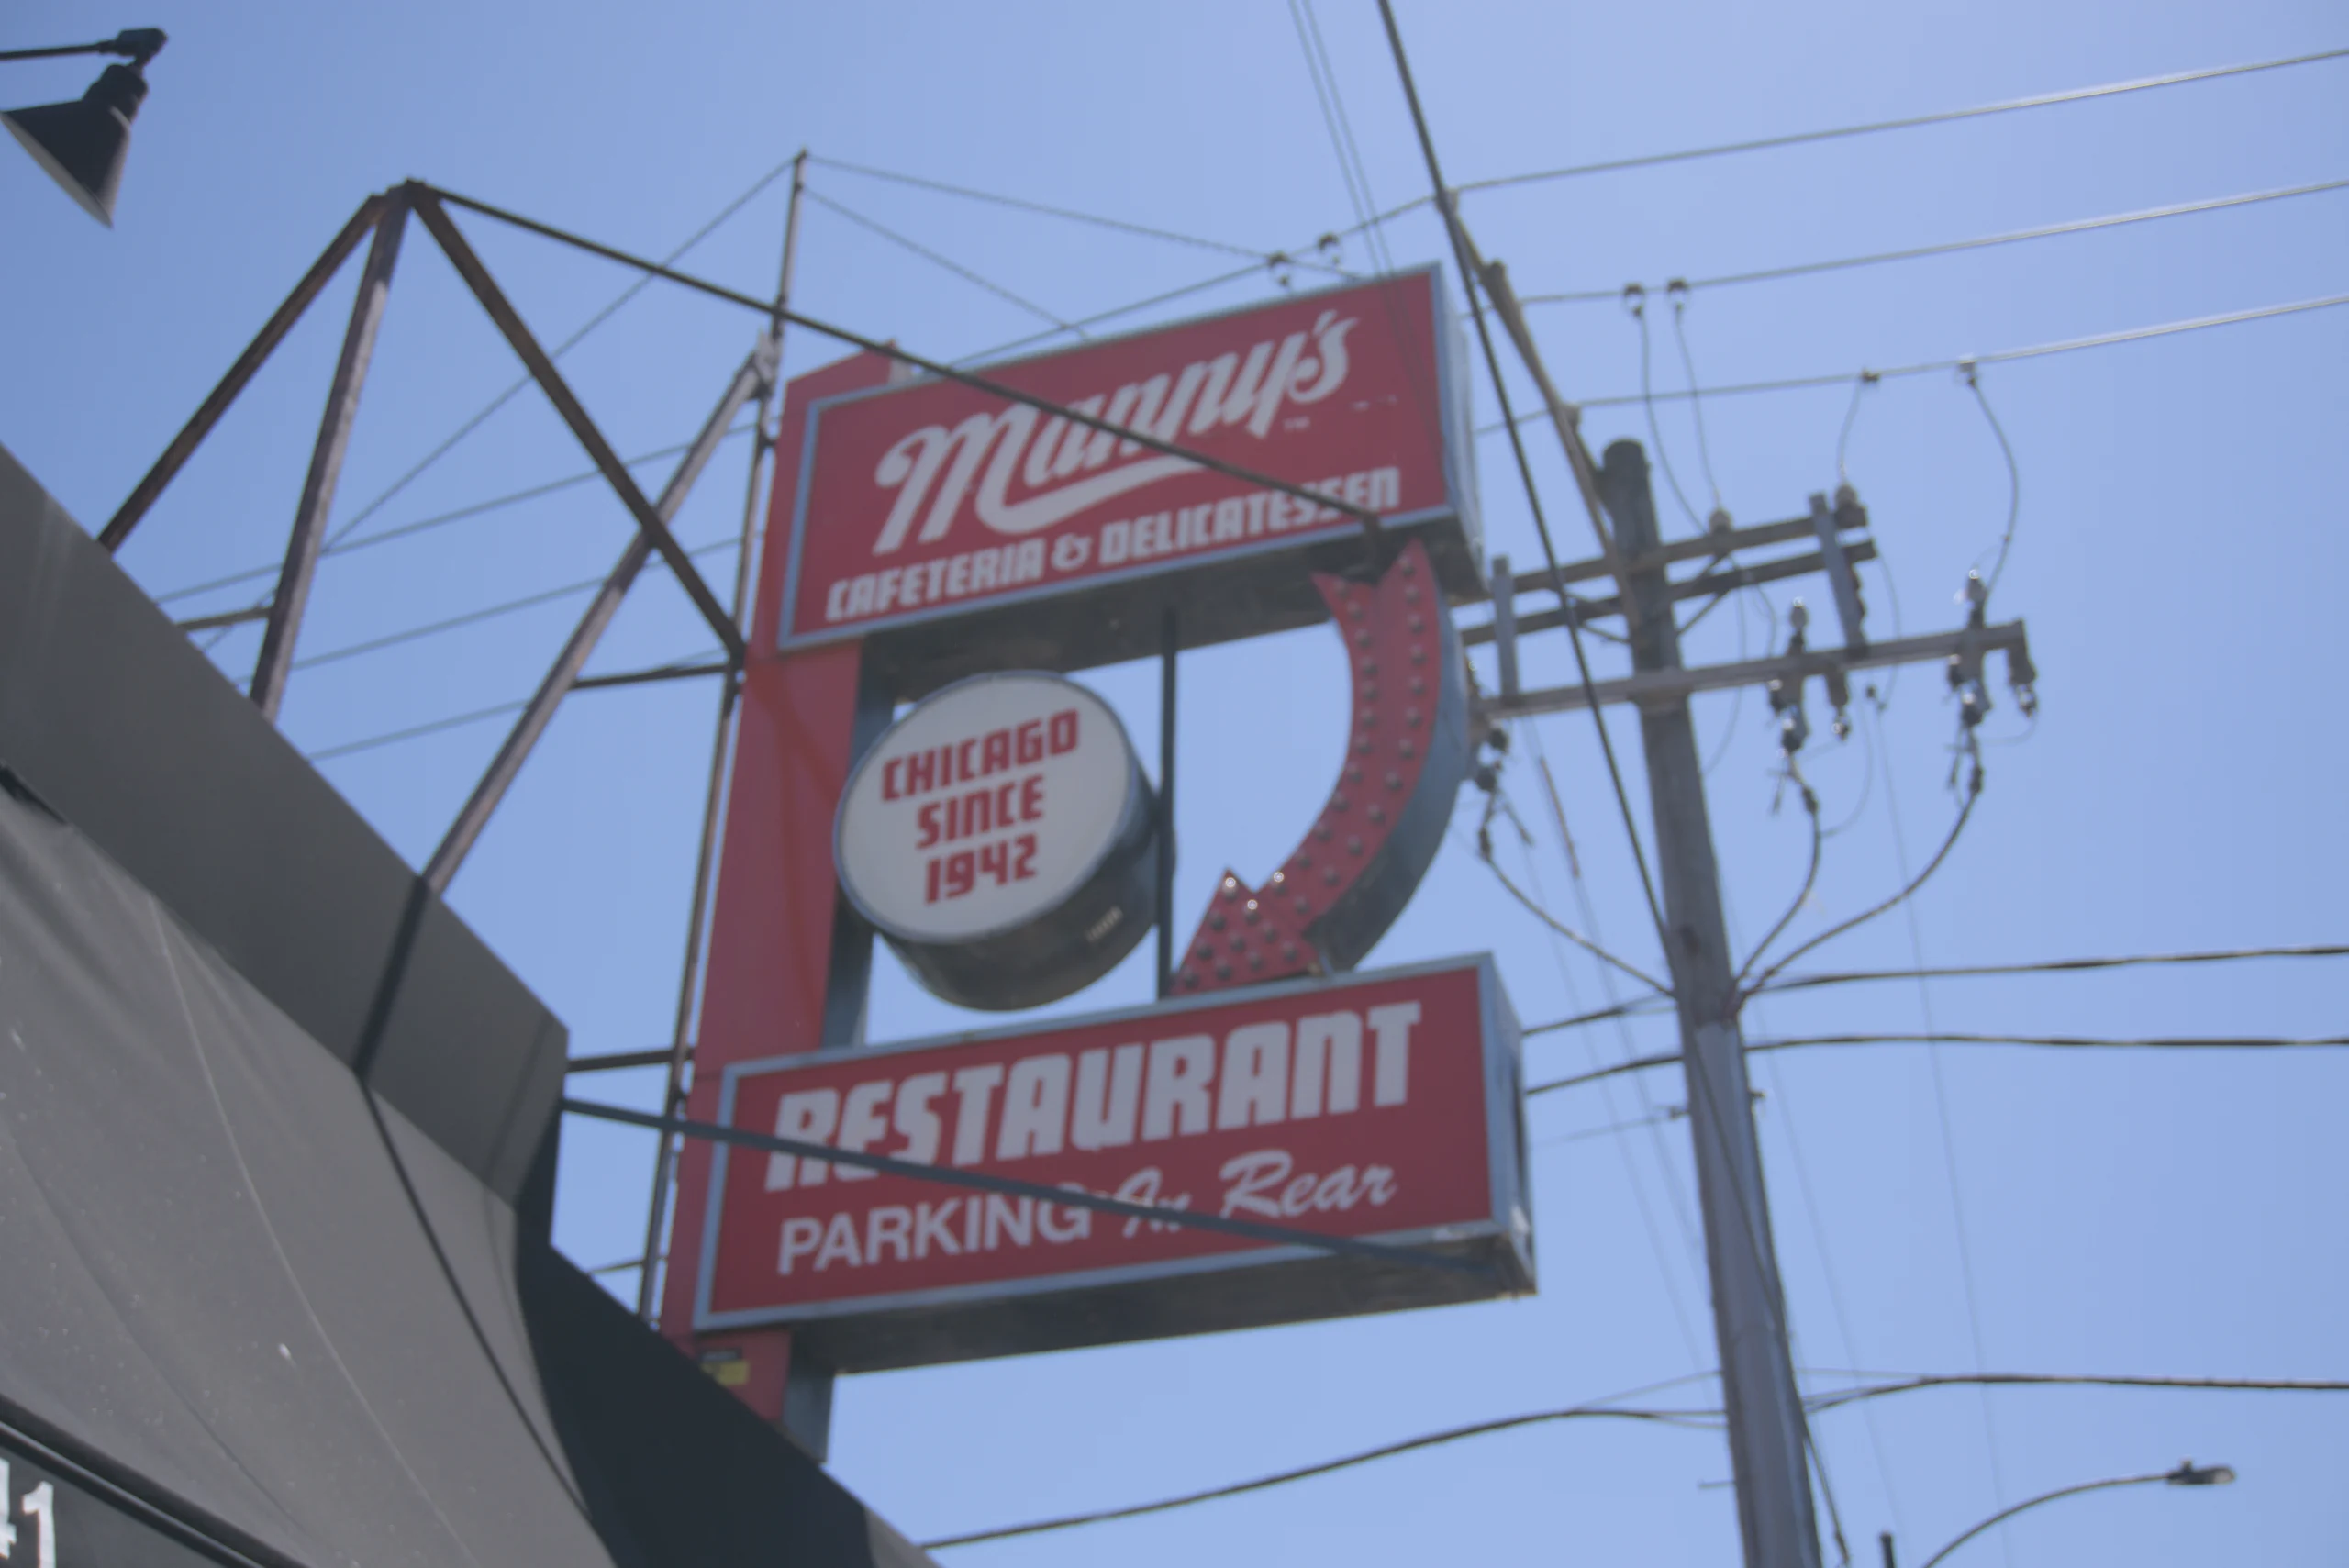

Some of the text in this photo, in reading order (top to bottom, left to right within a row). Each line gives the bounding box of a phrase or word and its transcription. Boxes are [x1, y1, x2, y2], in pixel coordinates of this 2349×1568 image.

[874, 310, 1358, 555] Manny's
[825, 466, 1400, 621] CAFETERIA & DELICATESSEN
[881, 709, 1078, 803] CHICAGO
[916, 774, 1044, 850] SINCE
[925, 833, 1039, 906] 1942
[764, 1001, 1421, 1192] RESTAURANT
[777, 1180, 1092, 1274] PARKING
[1219, 1150, 1398, 1218] Rear
